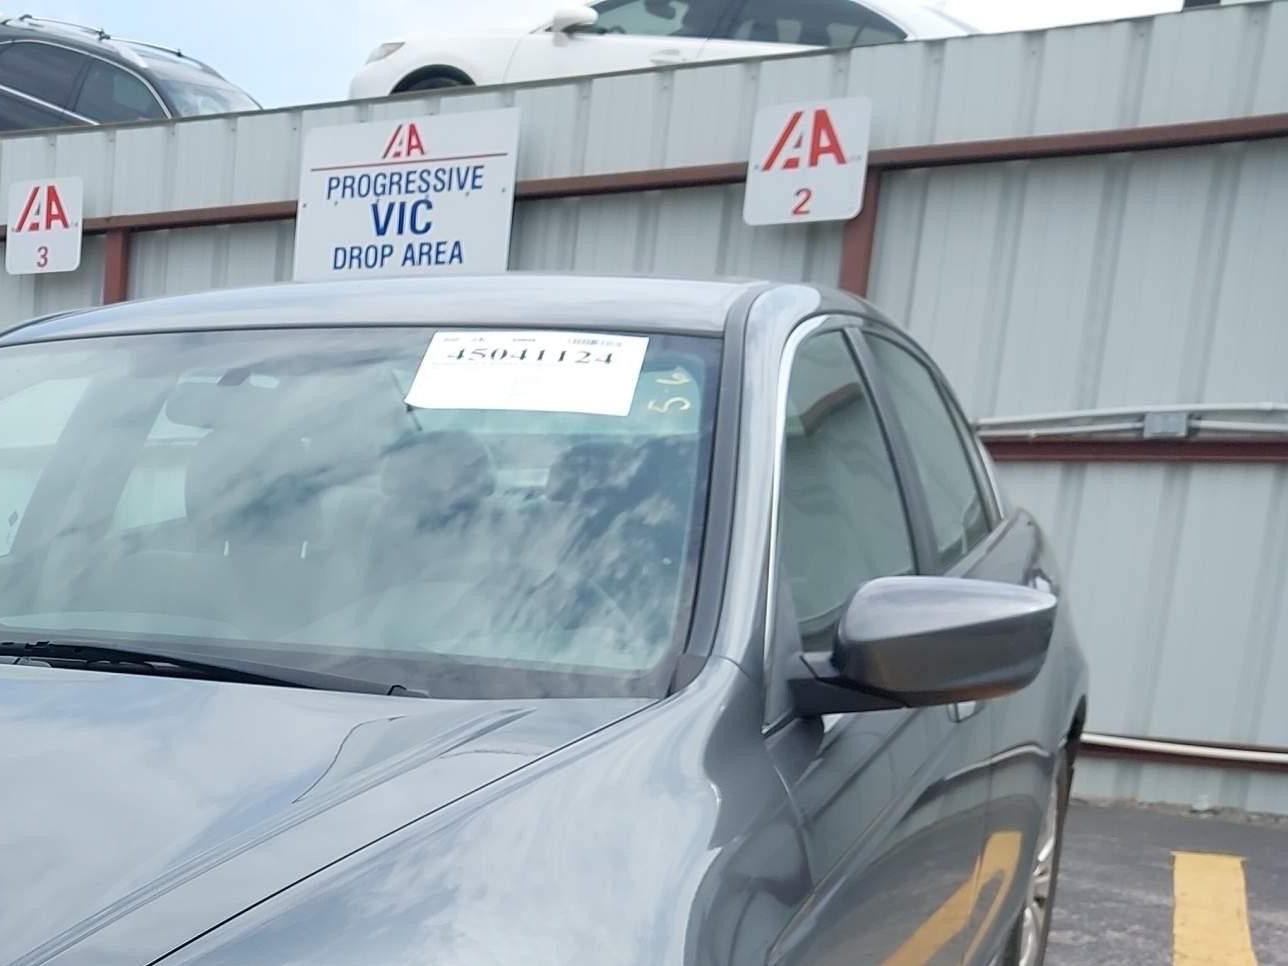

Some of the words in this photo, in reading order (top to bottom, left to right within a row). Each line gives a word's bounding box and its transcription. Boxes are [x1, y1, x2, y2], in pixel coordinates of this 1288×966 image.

[327, 165, 484, 200] PROGRESSIVE
[793, 188, 812, 215] 2
[371, 199, 433, 236] VIC
[37, 246, 48, 268] 3
[333, 244, 394, 270] DROP
[401, 240, 463, 266] AREA
[447, 347, 614, 365] 45041124
